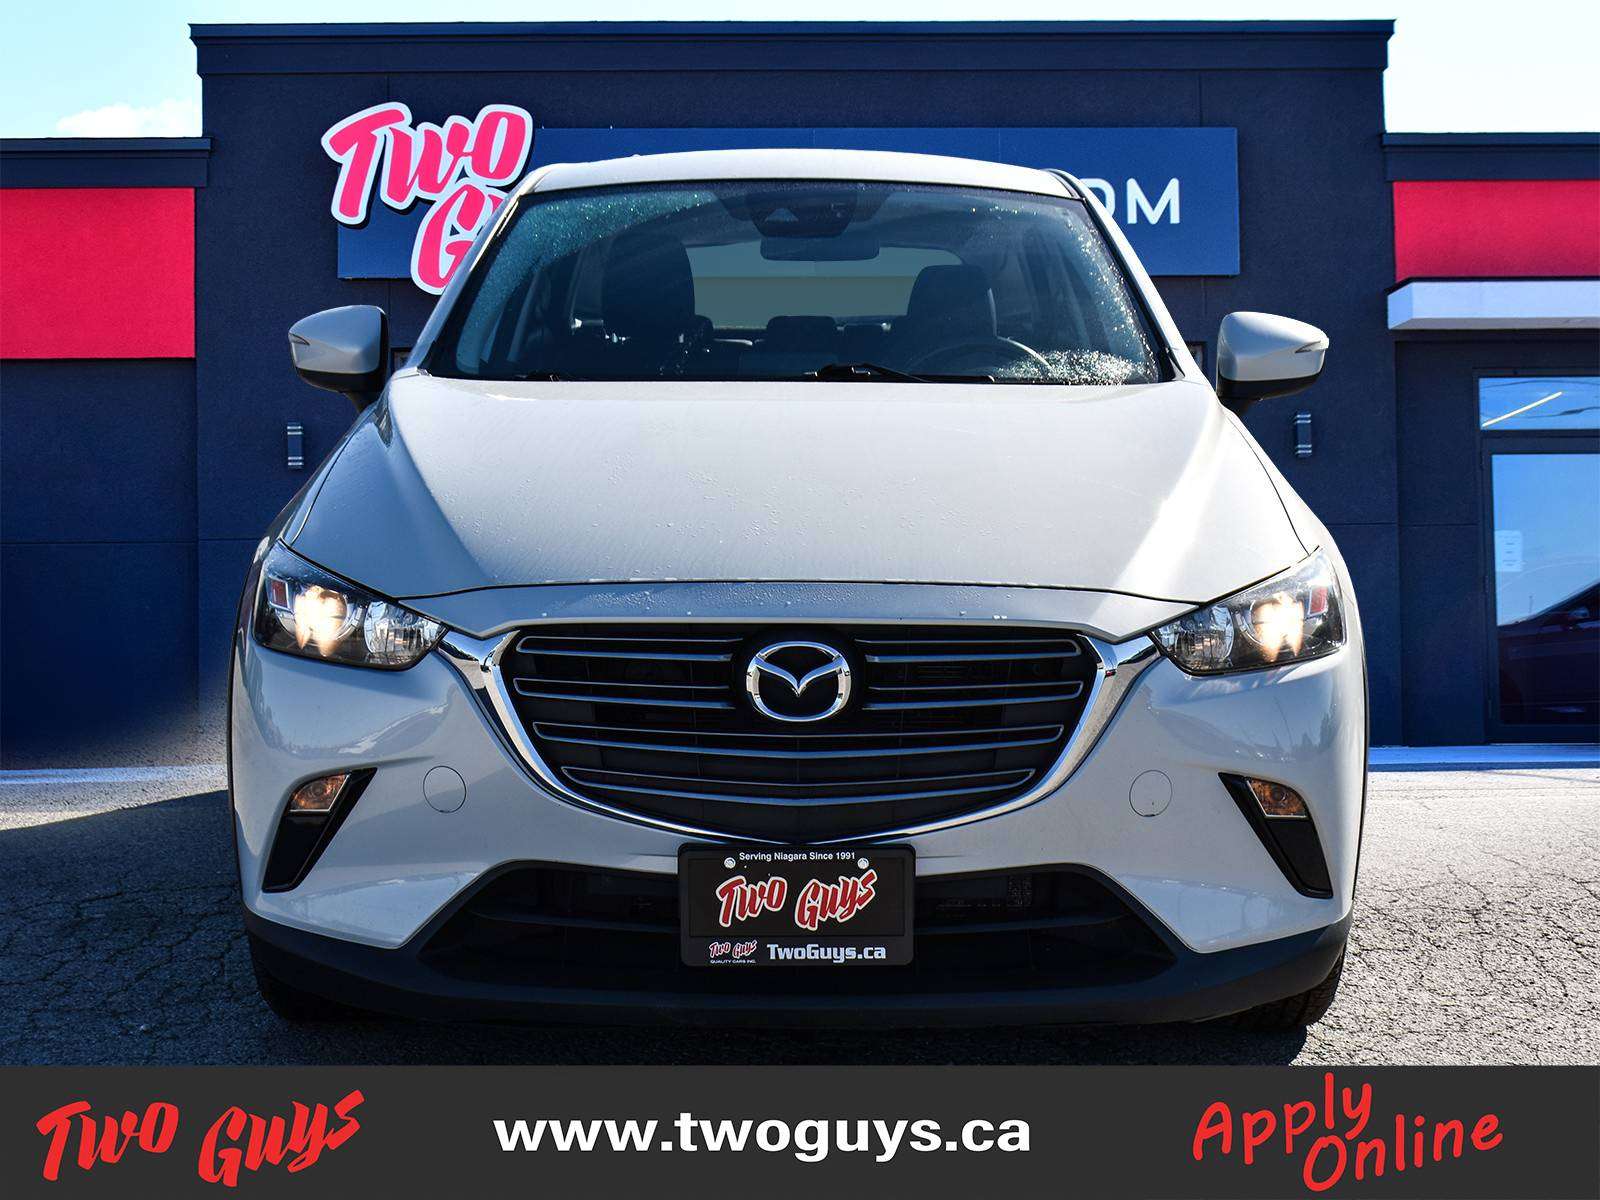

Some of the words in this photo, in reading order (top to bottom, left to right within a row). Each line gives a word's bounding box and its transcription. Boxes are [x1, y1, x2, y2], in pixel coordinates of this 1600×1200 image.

[739, 851, 772, 863] Serving
[774, 851, 808, 863] Niagara
[809, 851, 834, 861] Since
[835, 851, 856, 861] 1991
[794, 869, 878, 931] Guys
[766, 943, 886, 964] TwoGuys.ca
